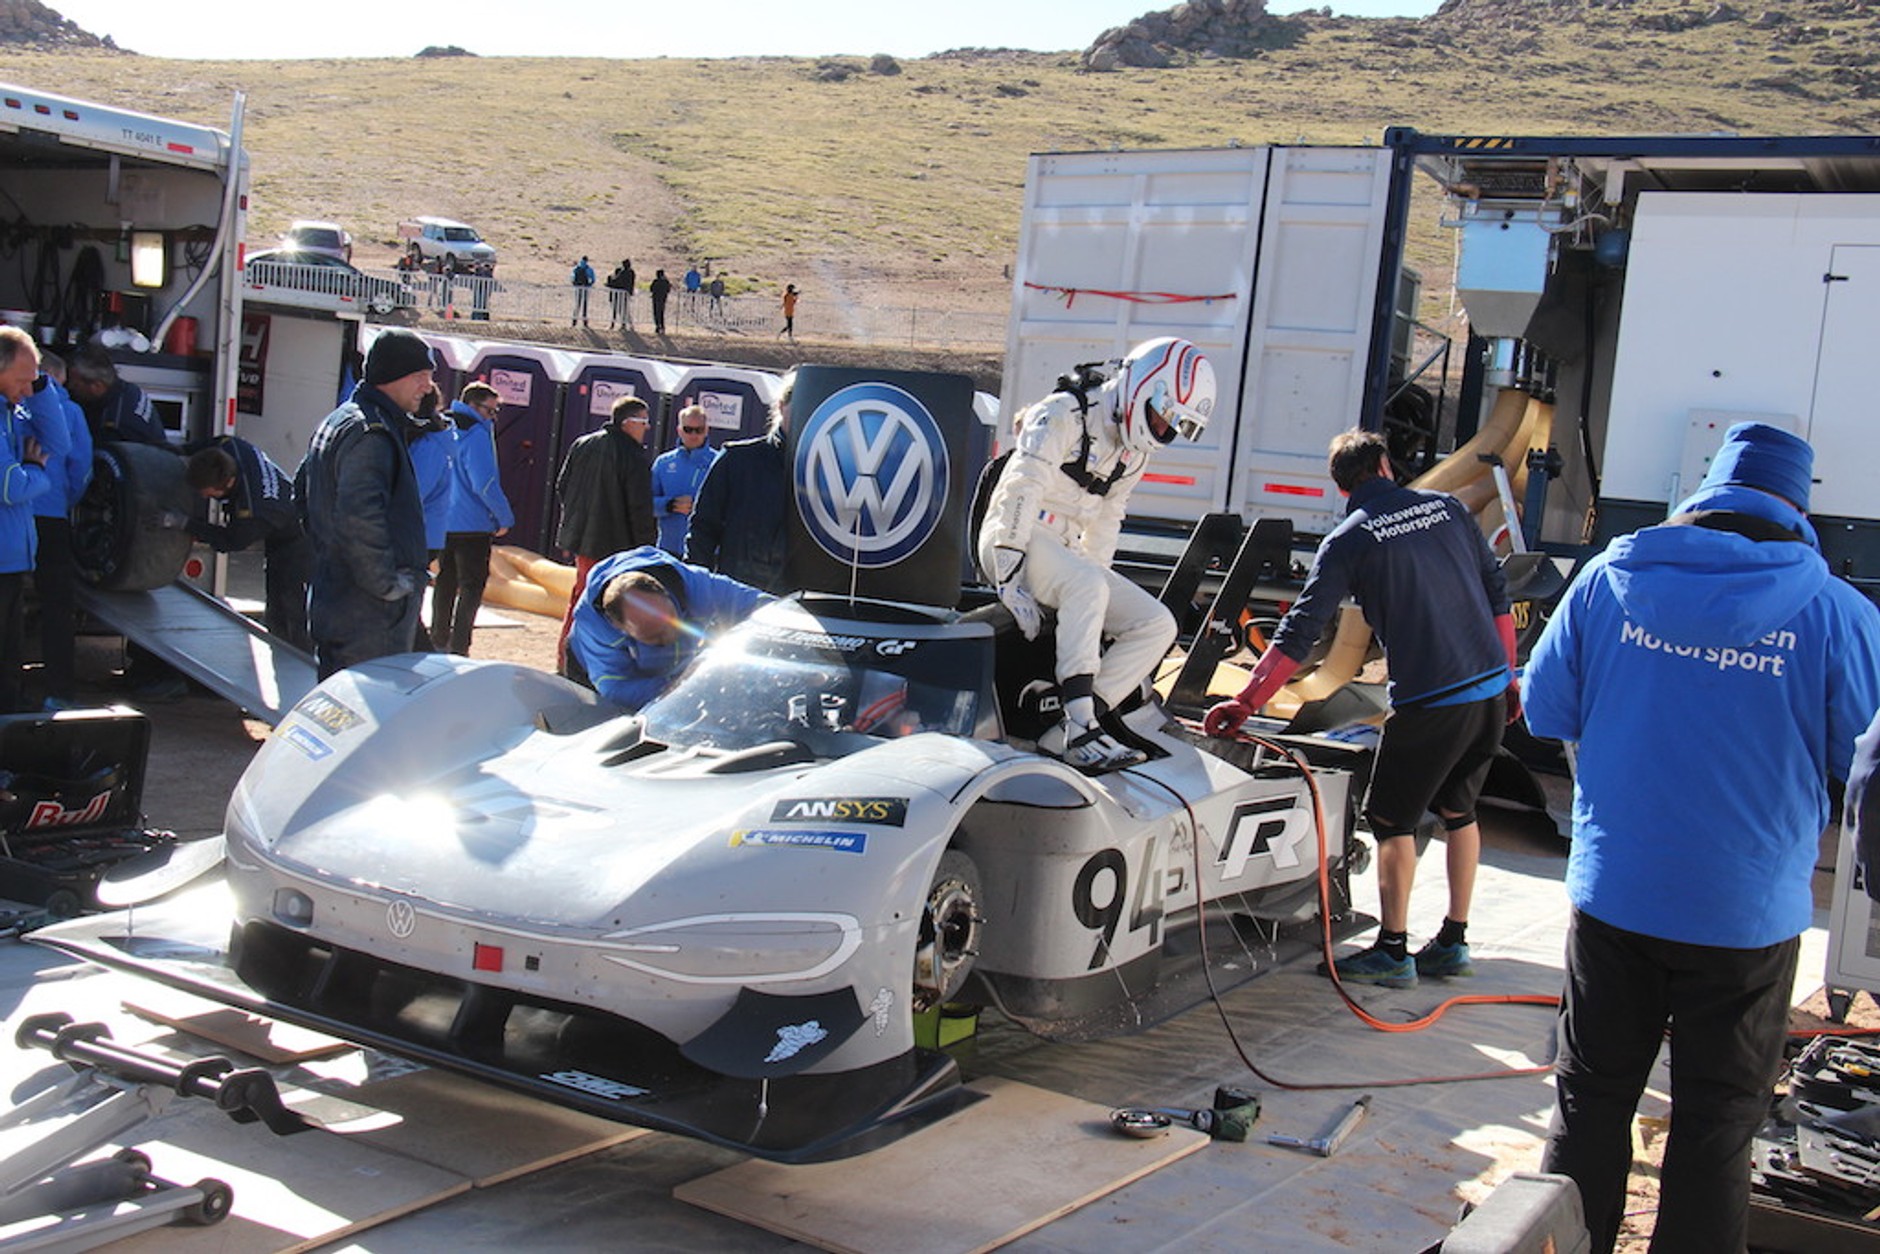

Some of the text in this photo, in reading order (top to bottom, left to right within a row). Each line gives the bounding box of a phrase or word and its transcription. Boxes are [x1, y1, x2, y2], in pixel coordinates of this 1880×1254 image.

[121, 128, 133, 139] TT
[156, 135, 162, 146] E
[495, 376, 526, 389] United
[703, 400, 737, 412] United
[1360, 499, 1446, 532] Volkswagen
[1373, 510, 1451, 543] Motorsport
[25, 790, 112, 829] Bull
[786, 801, 892, 820] ANSYS
[768, 834, 855, 847] MICHELIN
[1220, 806, 1311, 881] R
[1072, 835, 1165, 970] 94
